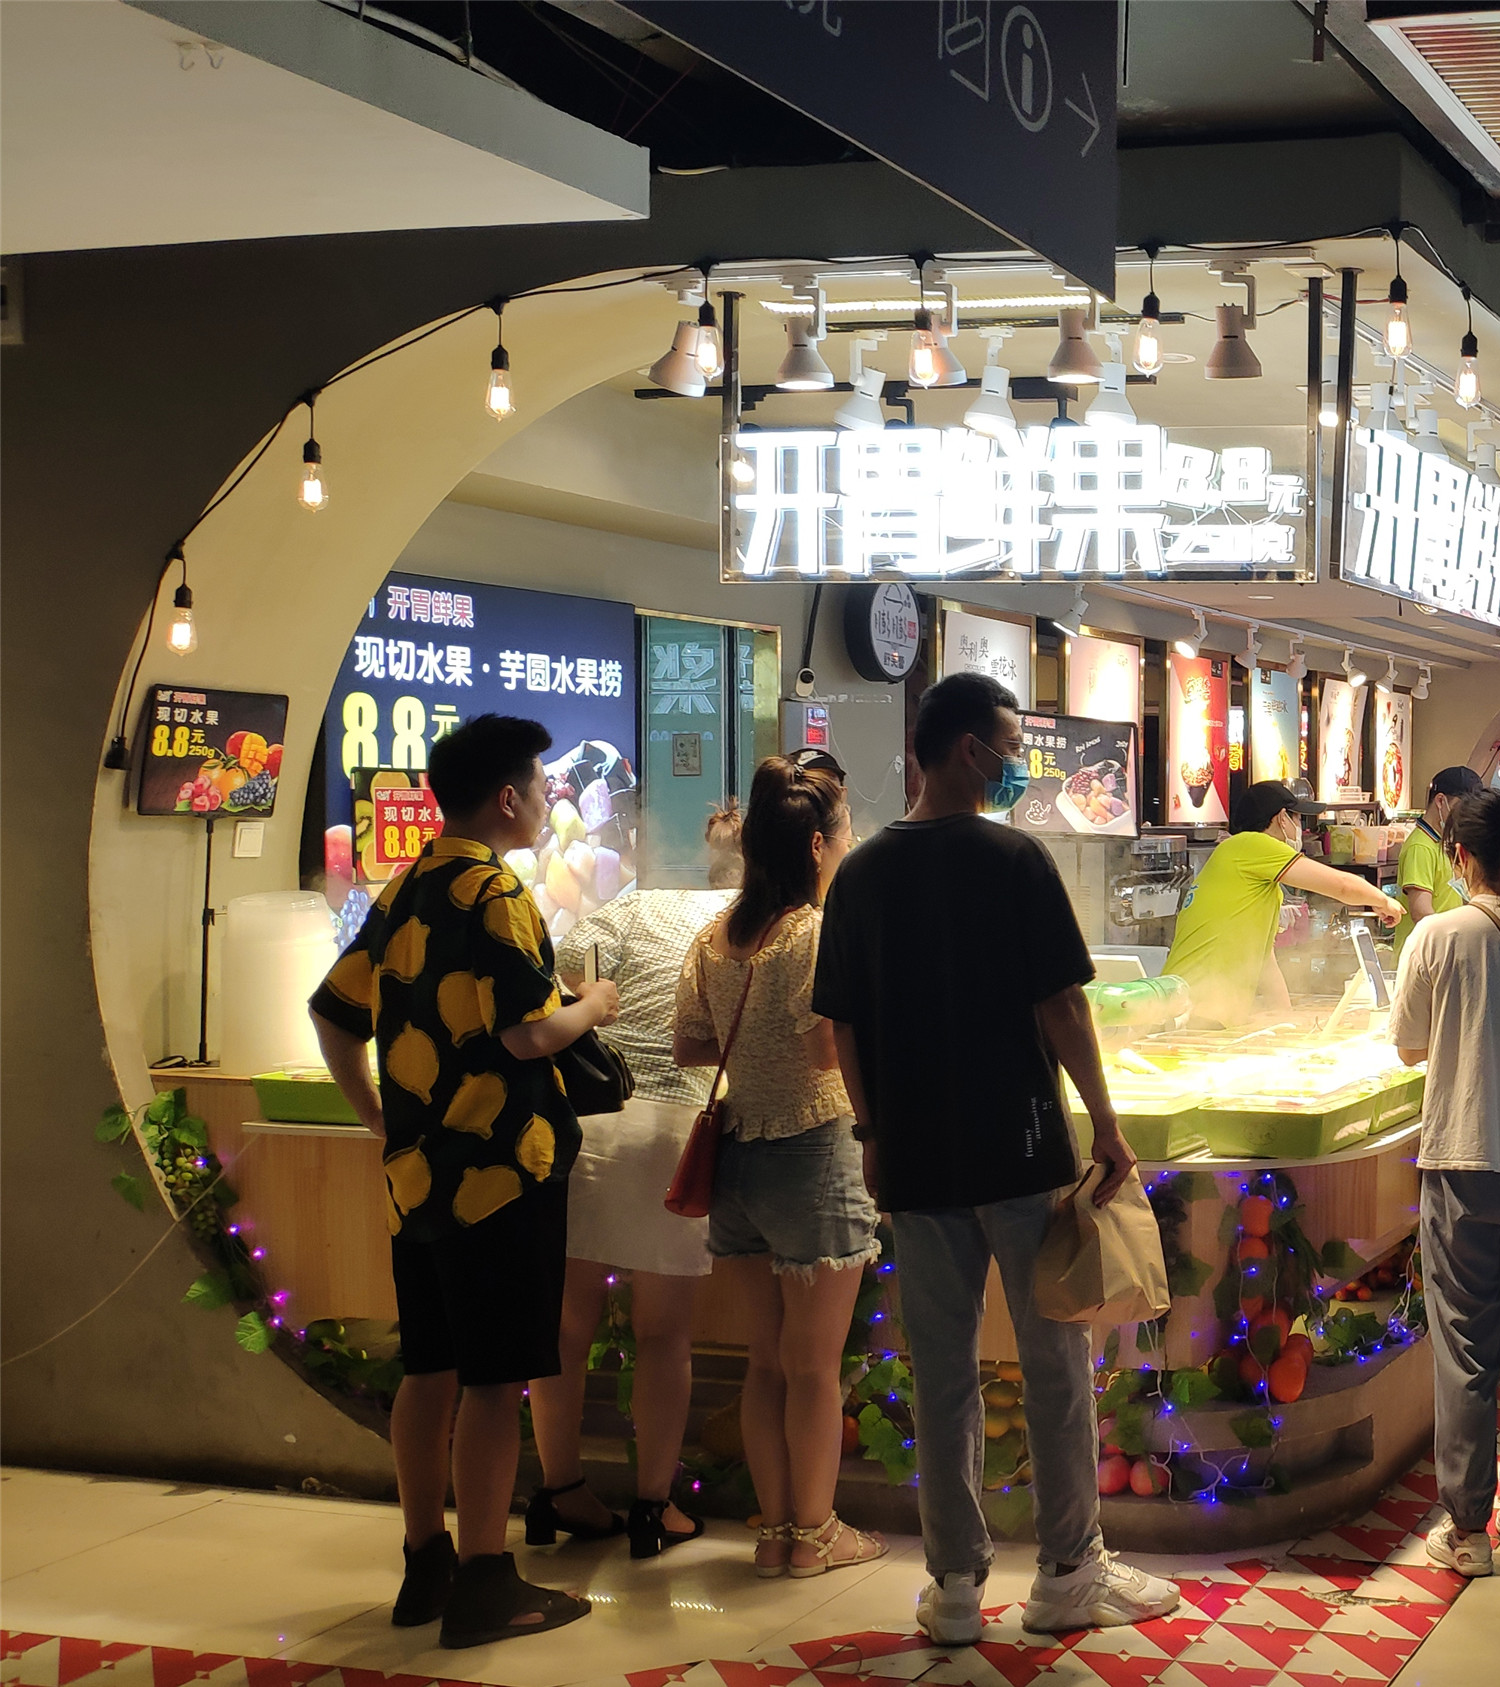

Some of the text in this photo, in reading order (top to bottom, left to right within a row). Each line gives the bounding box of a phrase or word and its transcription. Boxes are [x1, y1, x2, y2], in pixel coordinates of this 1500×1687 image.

[735, 426, 1168, 575] 开胃鲜果
[387, 586, 474, 628] 开胃鲜果
[959, 634, 989, 662] 奥利奥
[156, 706, 219, 726] 现切水果
[188, 744, 216, 759] 250g
[1043, 767, 1067, 781] 250g
[383, 806, 444, 822] 现切水果
